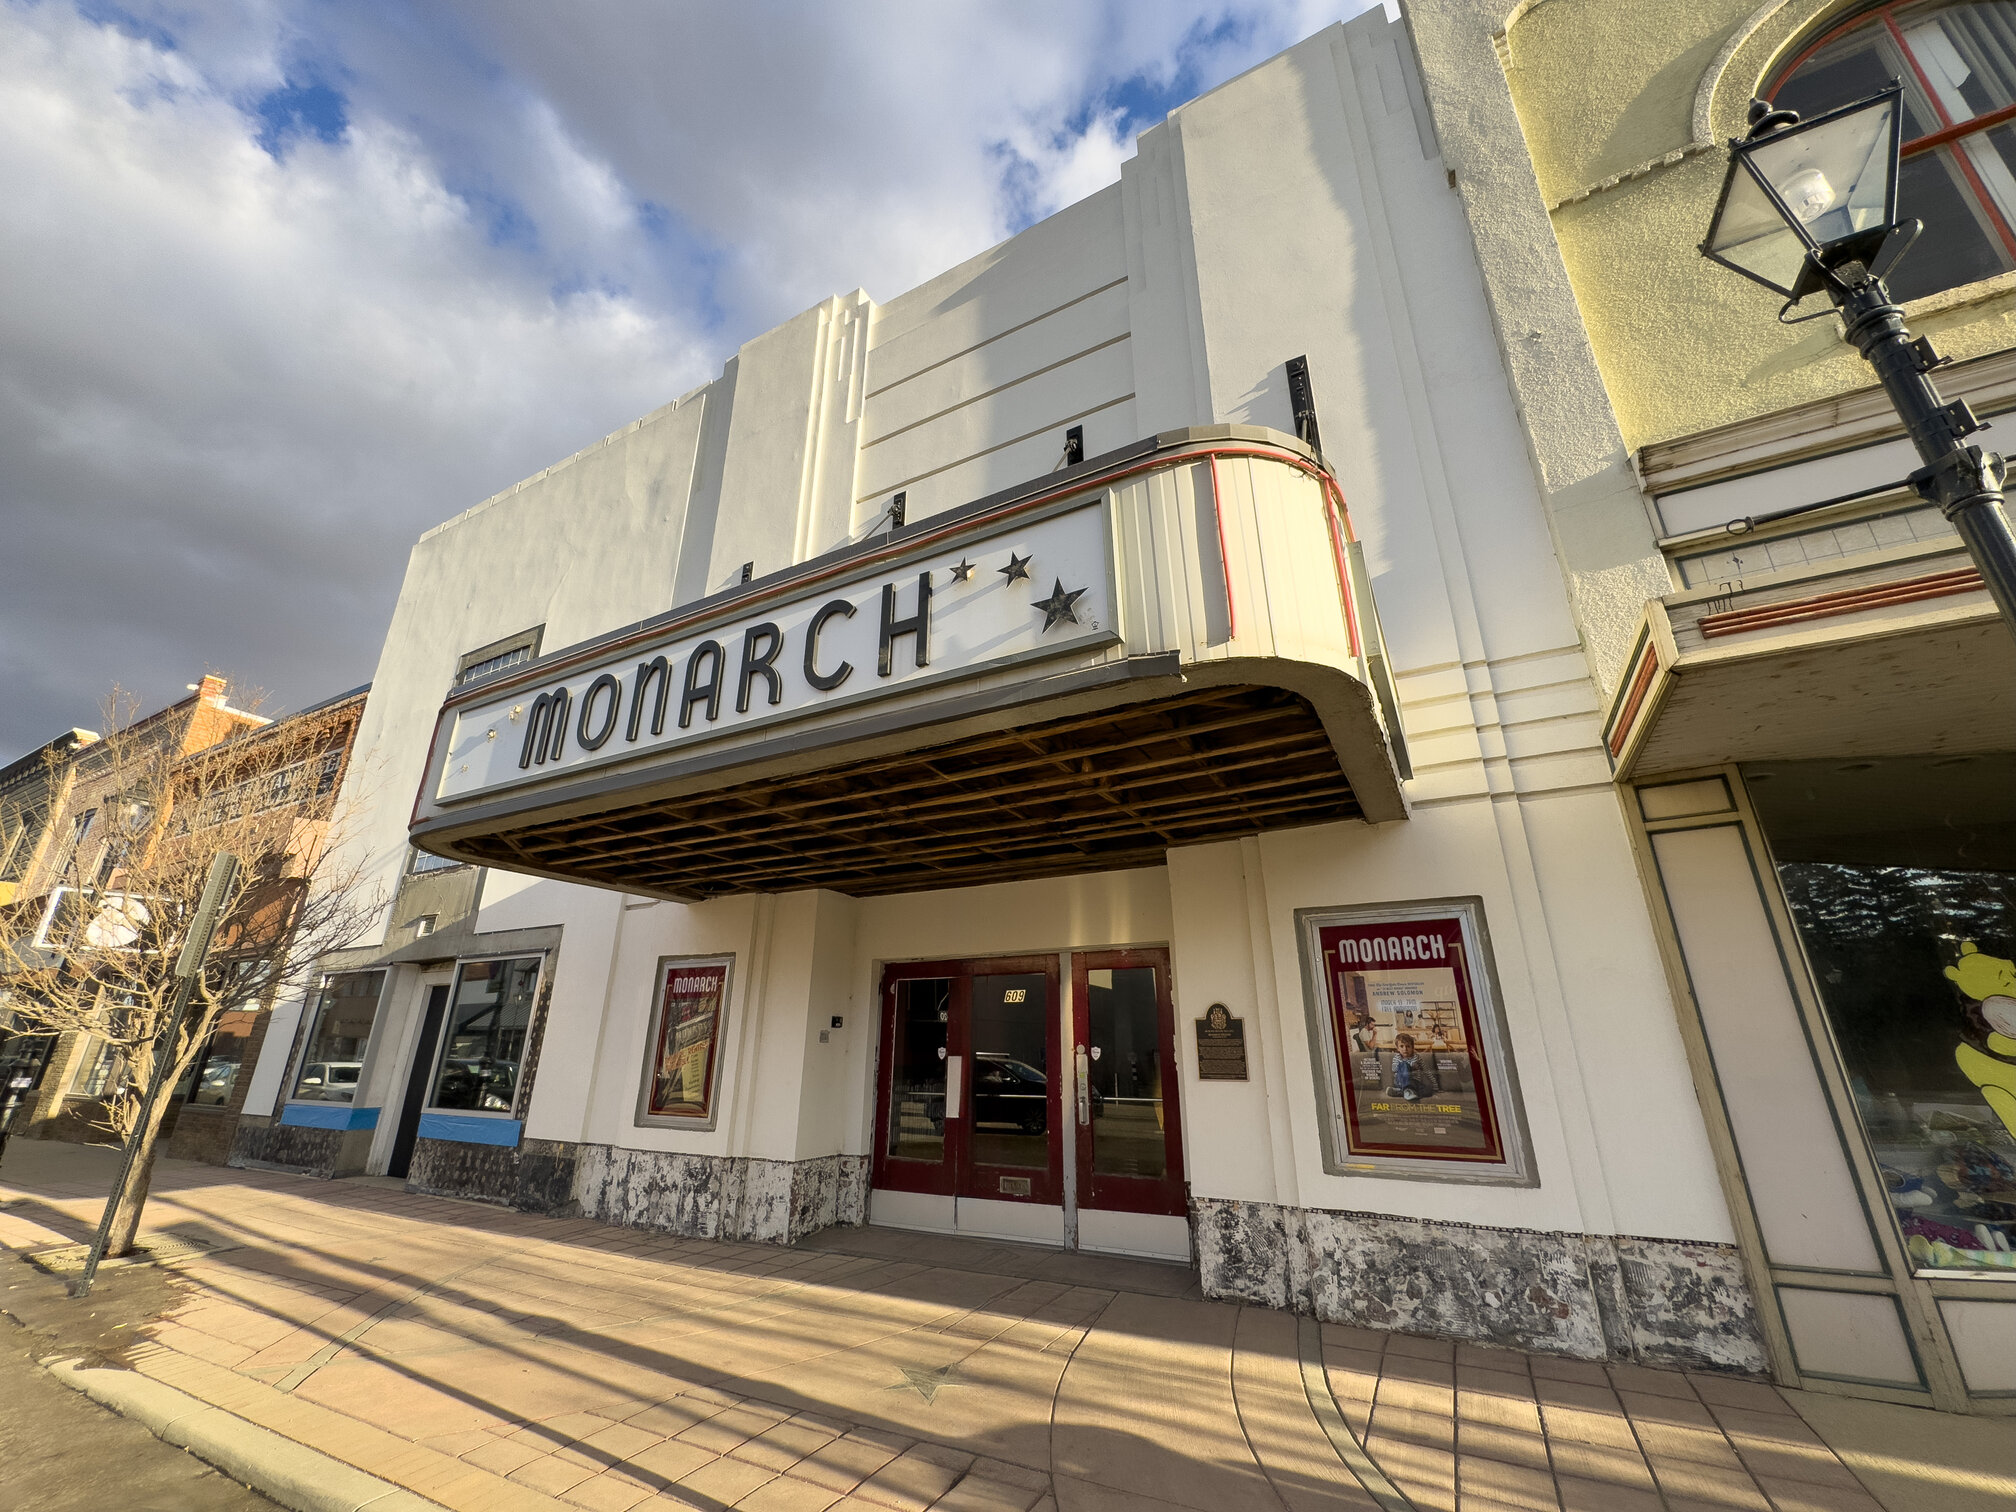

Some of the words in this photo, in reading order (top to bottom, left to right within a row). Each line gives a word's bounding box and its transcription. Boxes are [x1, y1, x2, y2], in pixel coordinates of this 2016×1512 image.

[518, 570, 933, 770] MONARCH
[1338, 933, 1446, 964] MONARCH
[672, 975, 719, 994] MONARCH
[1005, 990, 1025, 1002] 609
[1371, 1102, 1390, 1111] FAR
[1390, 1102, 1417, 1112] FROM
[1417, 1103, 1435, 1112] THE
[1435, 1104, 1462, 1113] TREE
